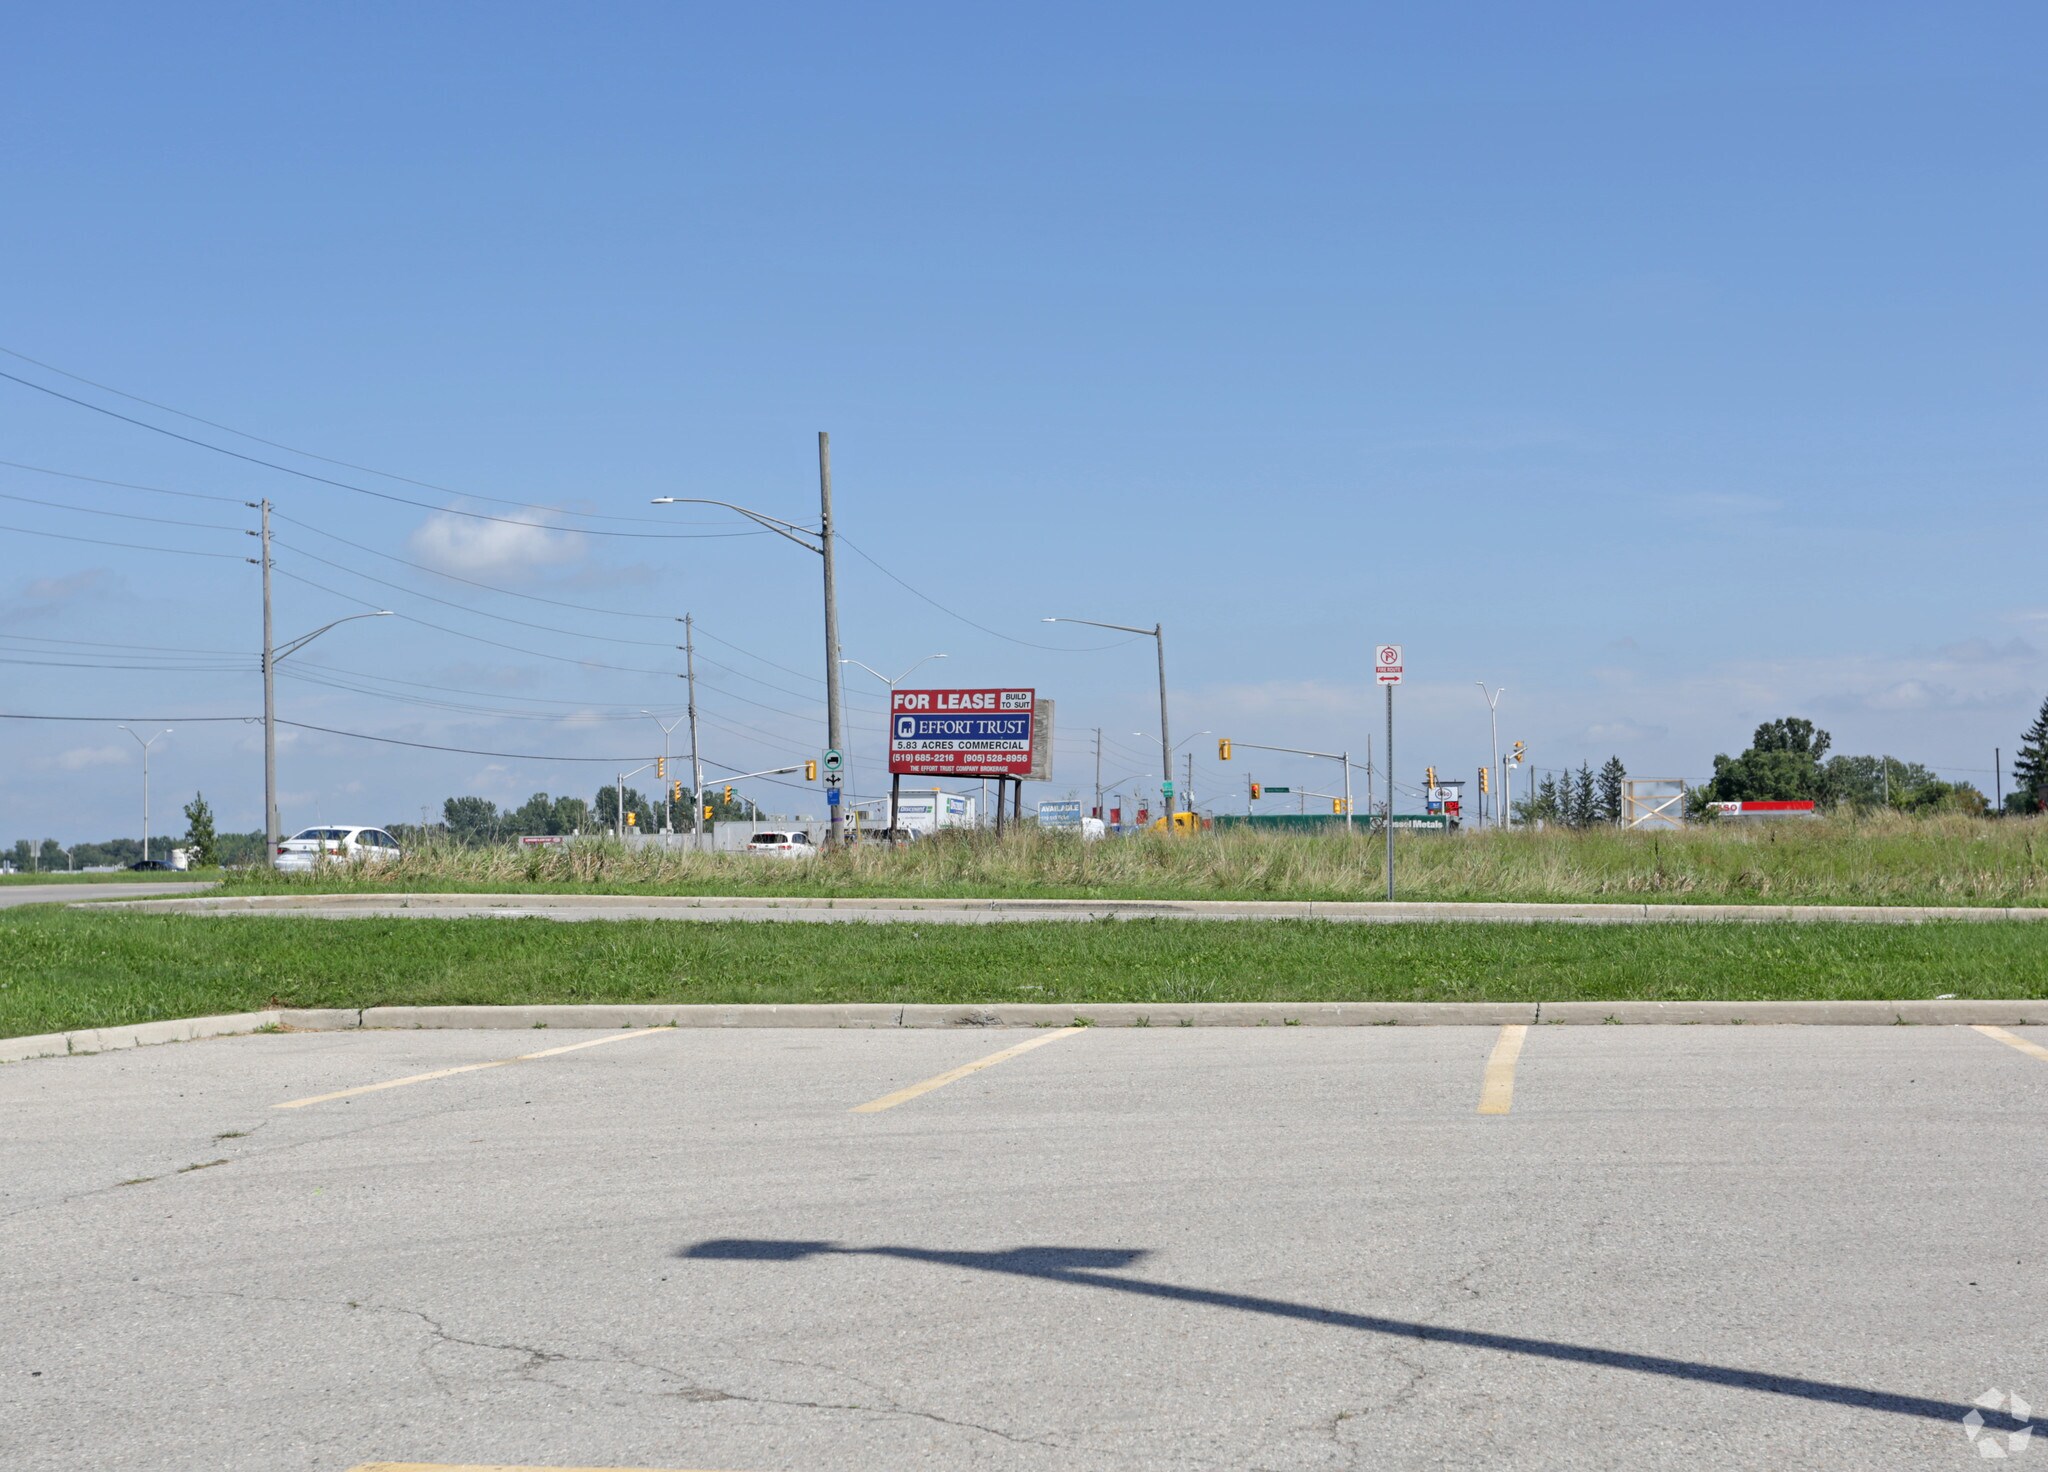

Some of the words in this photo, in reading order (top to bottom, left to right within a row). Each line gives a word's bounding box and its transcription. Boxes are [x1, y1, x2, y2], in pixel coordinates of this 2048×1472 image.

[893, 694, 930, 710] FOR
[937, 693, 996, 710] LEASE
[1005, 693, 1027, 701] BUILD
[1002, 701, 1012, 709] TO
[1014, 701, 1030, 709] SUIT
[919, 720, 974, 734] EFFORT
[977, 720, 1025, 734] TRUST
[897, 741, 917, 749] 5.83
[921, 741, 954, 749] ACRES
[958, 741, 1023, 750] COMMERCIAL
[892, 754, 914, 763] (519)
[914, 754, 954, 762] 685-2216
[963, 754, 985, 763] (905)
[986, 754, 1027, 762] 528-8956
[956, 765, 979, 773] COMPANY
[980, 765, 1009, 773] BROKERAGE
[1412, 819, 1443, 828] Metals
